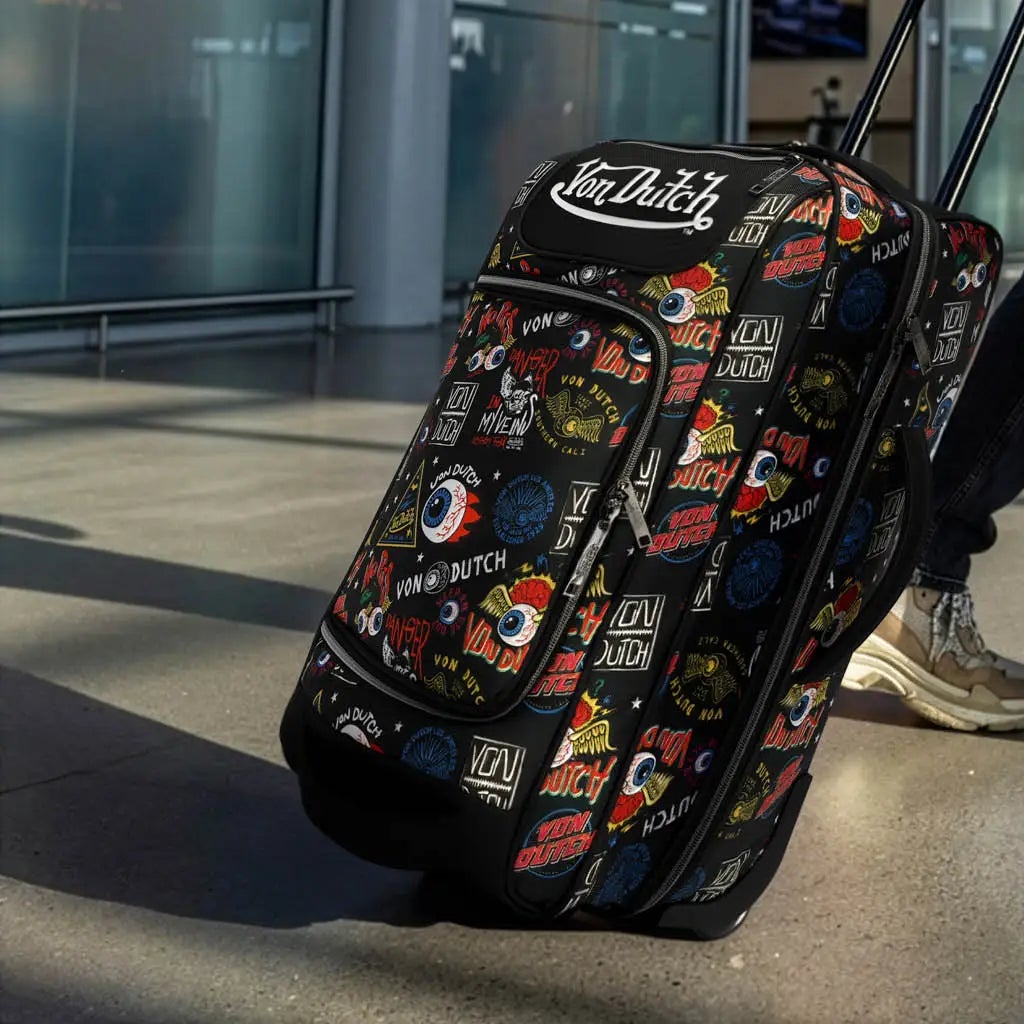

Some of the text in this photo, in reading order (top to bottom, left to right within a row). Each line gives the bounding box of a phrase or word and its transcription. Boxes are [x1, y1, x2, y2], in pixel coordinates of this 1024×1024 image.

[562, 157, 618, 207] Von
[605, 164, 729, 219] Dutch
[727, 222, 769, 245] UTCH
[523, 311, 554, 337] VON
[730, 317, 780, 346] VON
[591, 336, 631, 380] VON
[714, 353, 771, 381] DUTCH
[560, 373, 586, 389] VON
[587, 382, 621, 425] DUTCH
[560, 444, 587, 457] CALI
[451, 463, 483, 489] DUTCH
[668, 503, 720, 532] VON
[397, 572, 424, 601] VON
[449, 548, 507, 584] DUTCH
[462, 610, 501, 665] VON
[433, 653, 460, 673] VON
[351, 706, 384, 739] DUTCH
[470, 742, 521, 783] VON
[536, 810, 594, 843] VON
